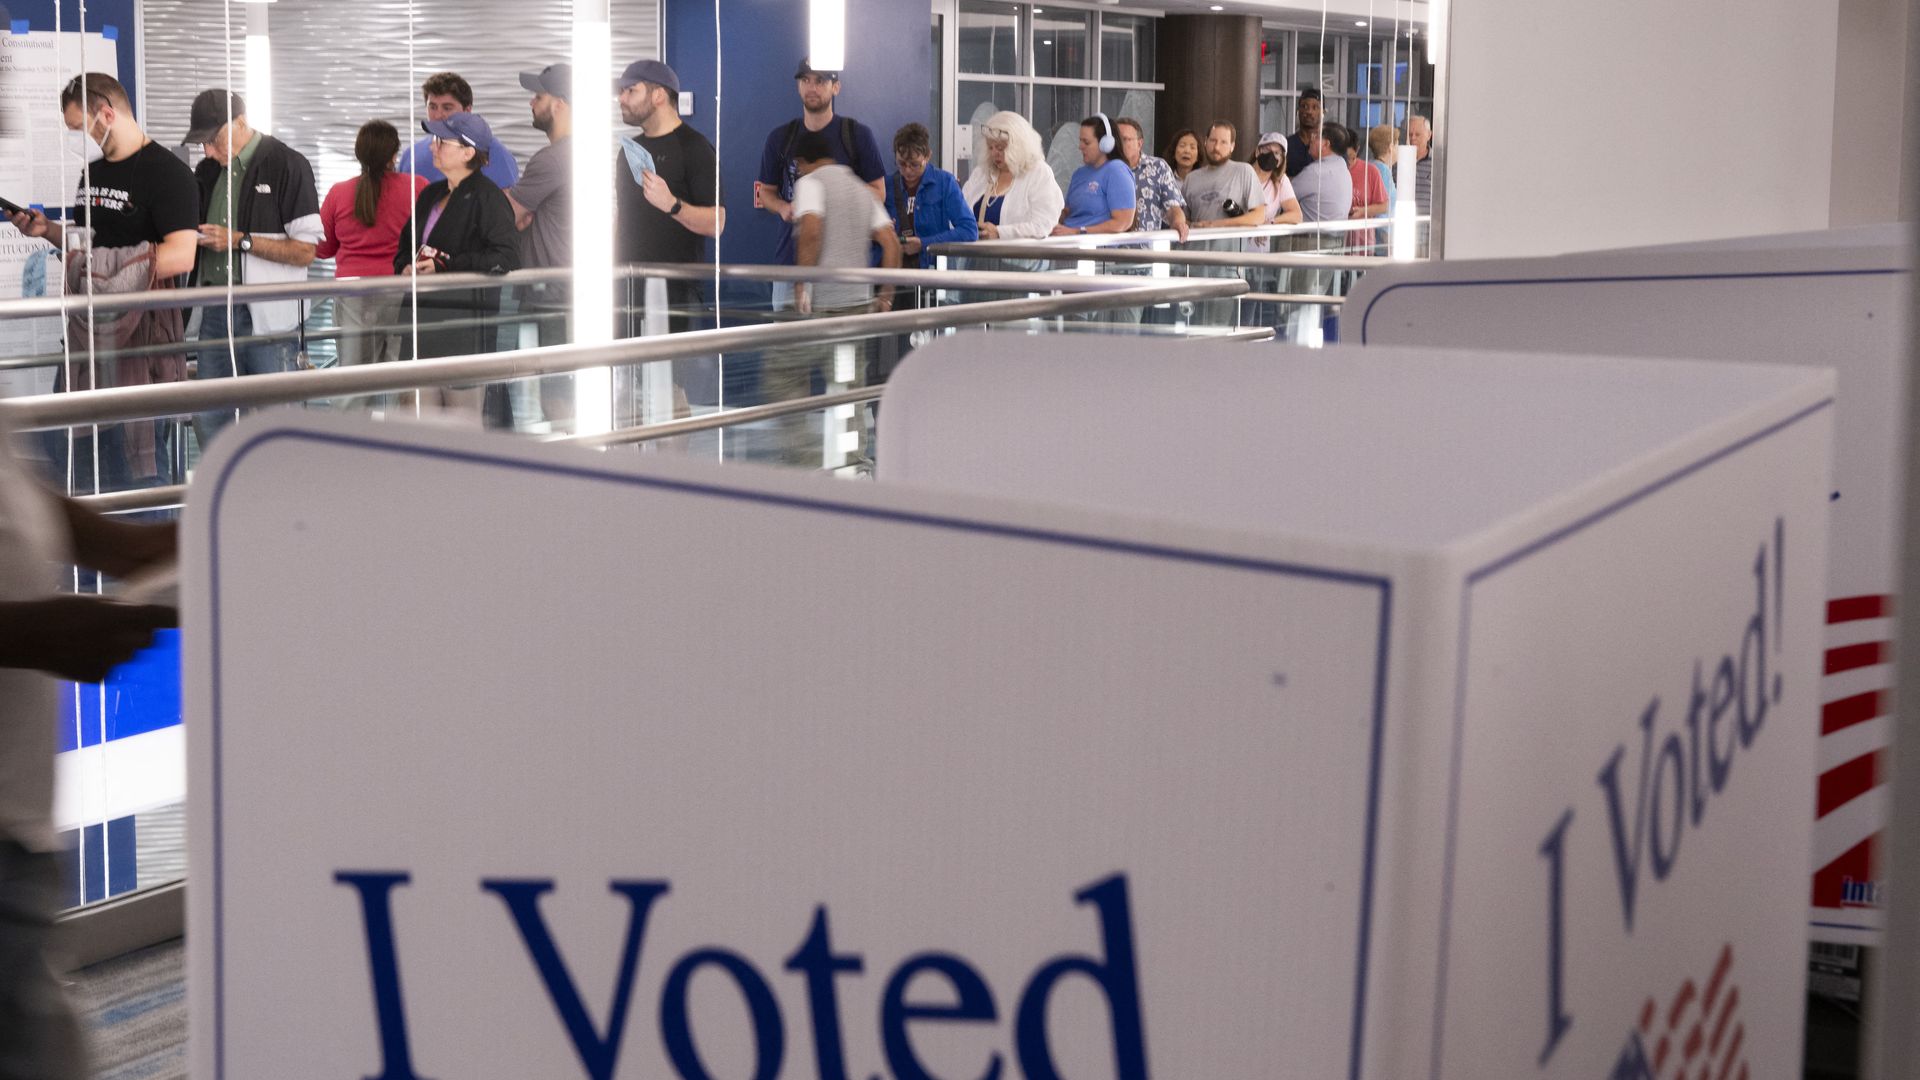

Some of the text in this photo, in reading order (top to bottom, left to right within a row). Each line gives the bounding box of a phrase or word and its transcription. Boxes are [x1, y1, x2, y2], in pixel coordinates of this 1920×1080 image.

[2, 37, 54, 49] Constitutional
[109, 188, 129, 201] FOR
[1597, 514, 1784, 935] Voted!
[333, 870, 1152, 1080] I Voted
